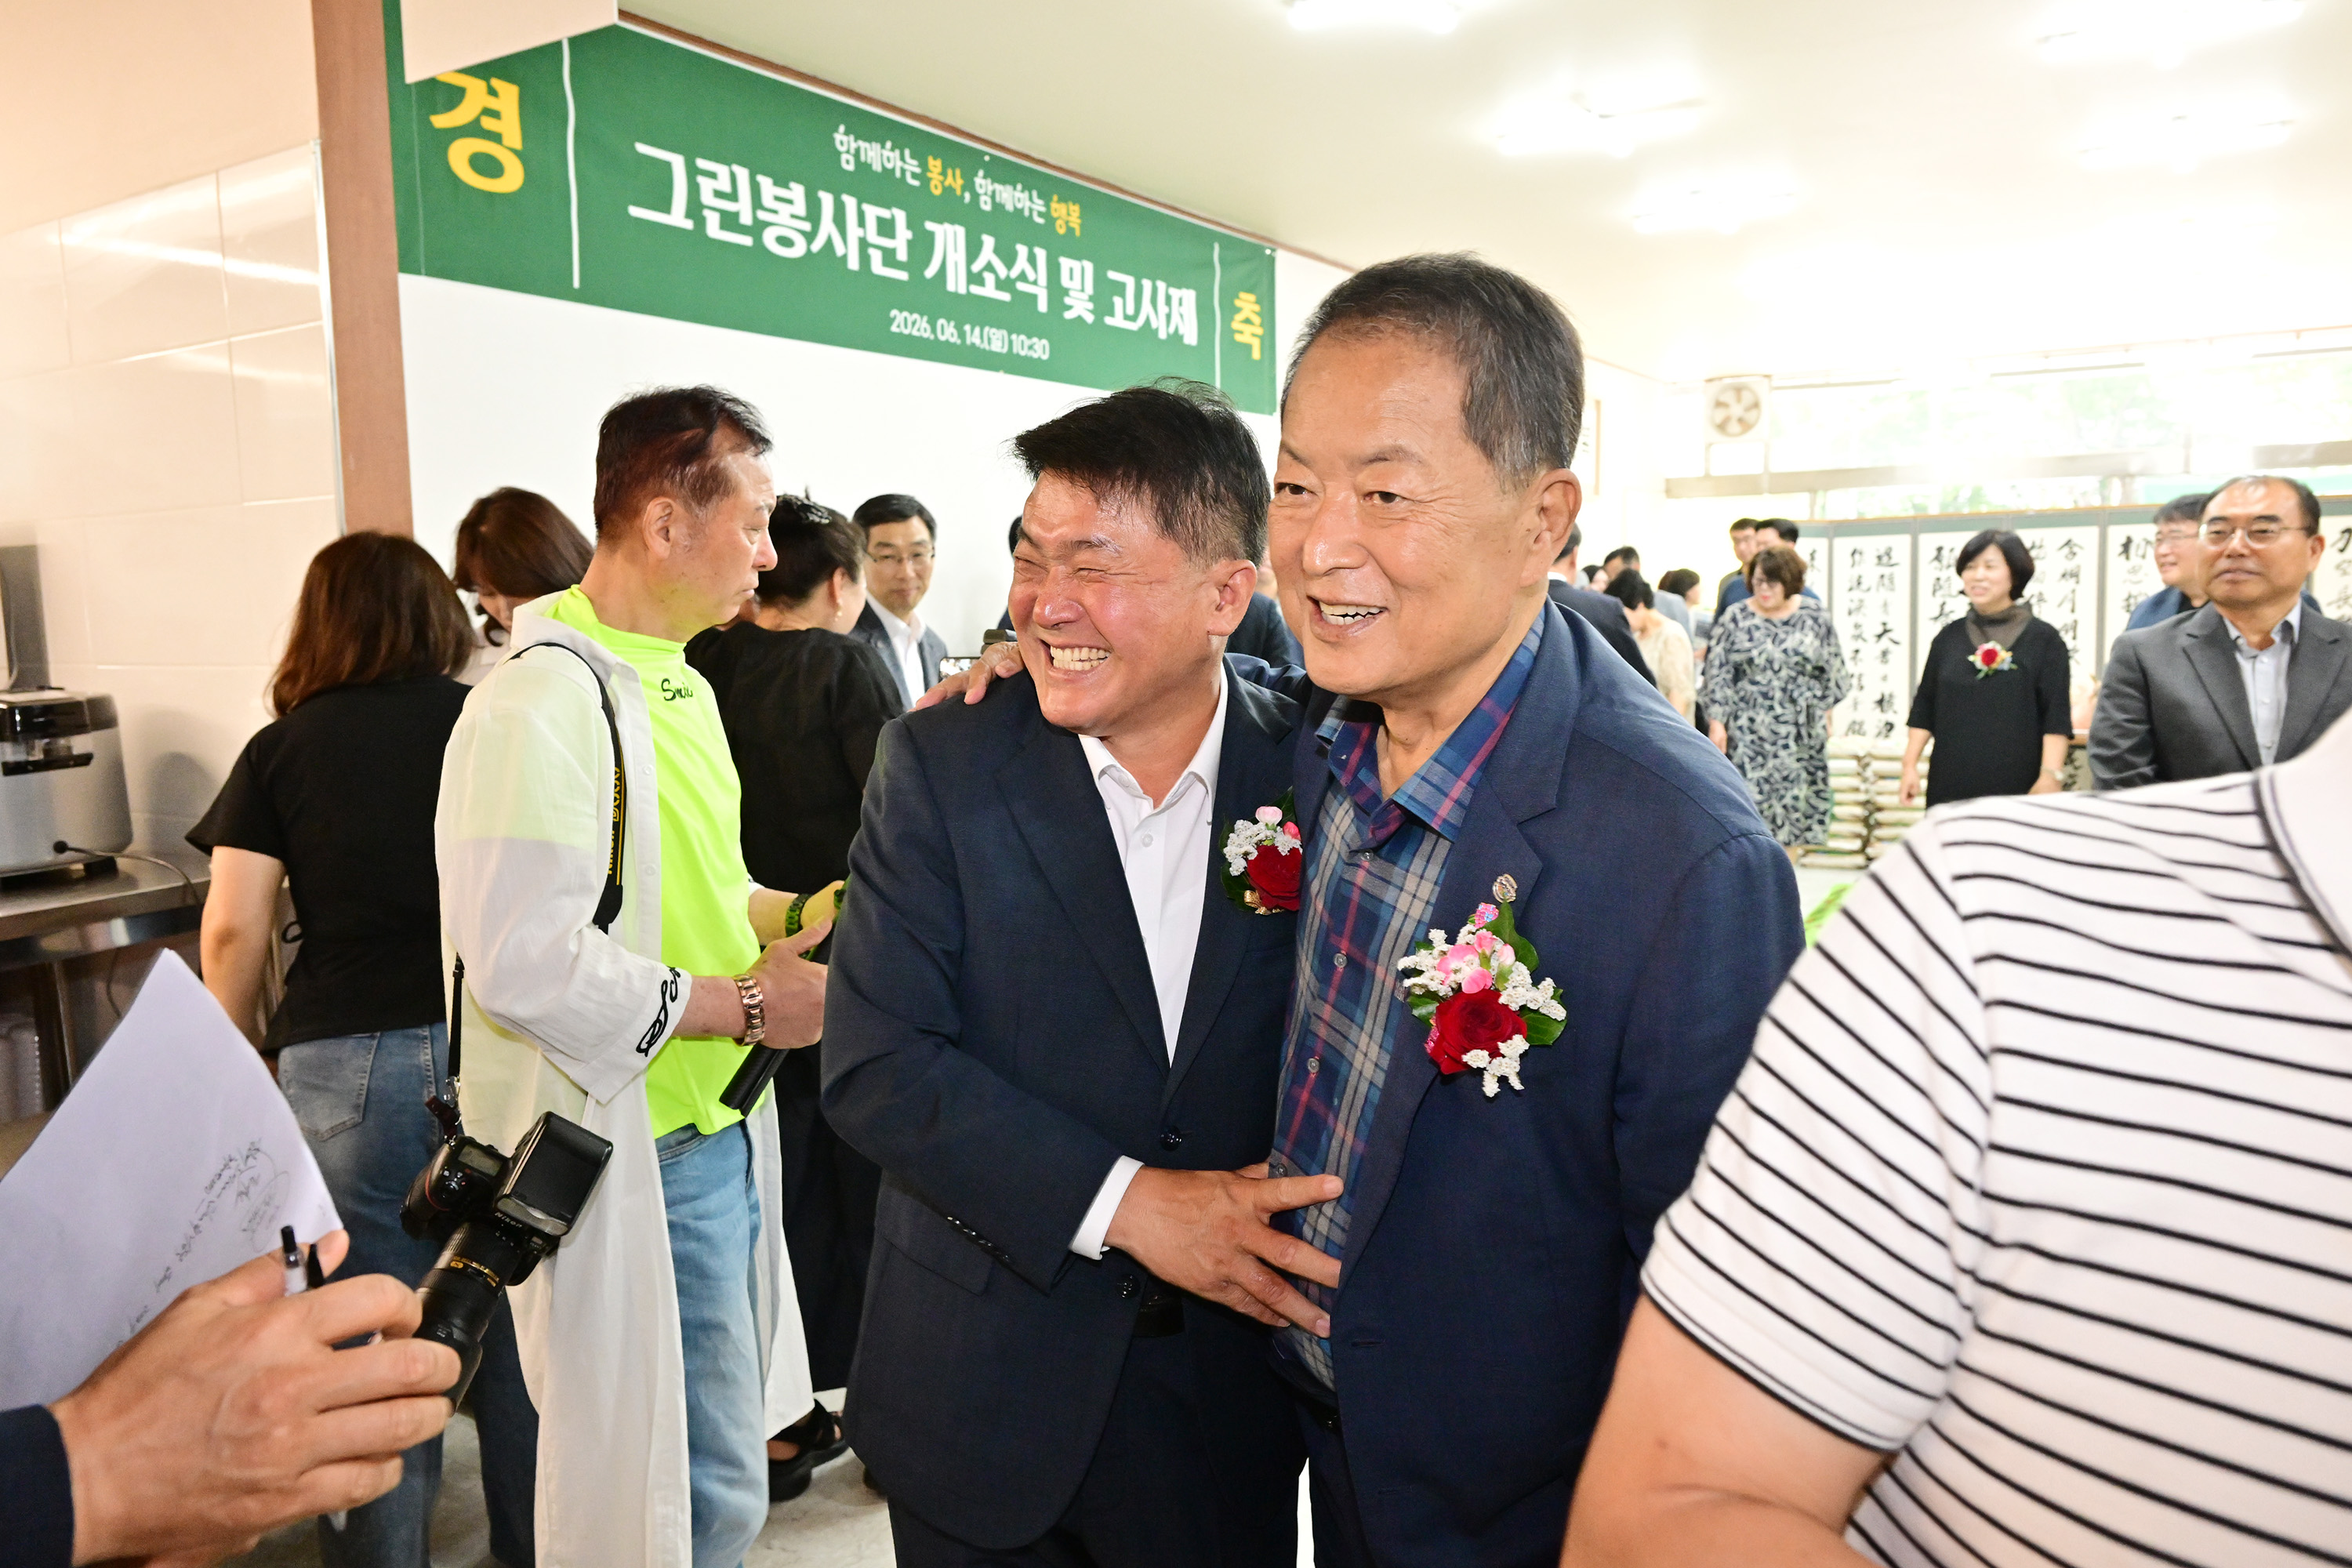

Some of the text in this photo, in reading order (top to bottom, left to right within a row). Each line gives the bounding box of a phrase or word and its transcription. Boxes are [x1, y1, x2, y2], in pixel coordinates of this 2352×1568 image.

[429, 70, 524, 194] 경
[833, 124, 1082, 237] 함께하는 봉사, 함께하는 행복
[628, 142, 1199, 347] 그린봉사단 개소식 및 고사제
[1010, 332, 1051, 361] 10:30
[1231, 291, 1265, 361] 축
